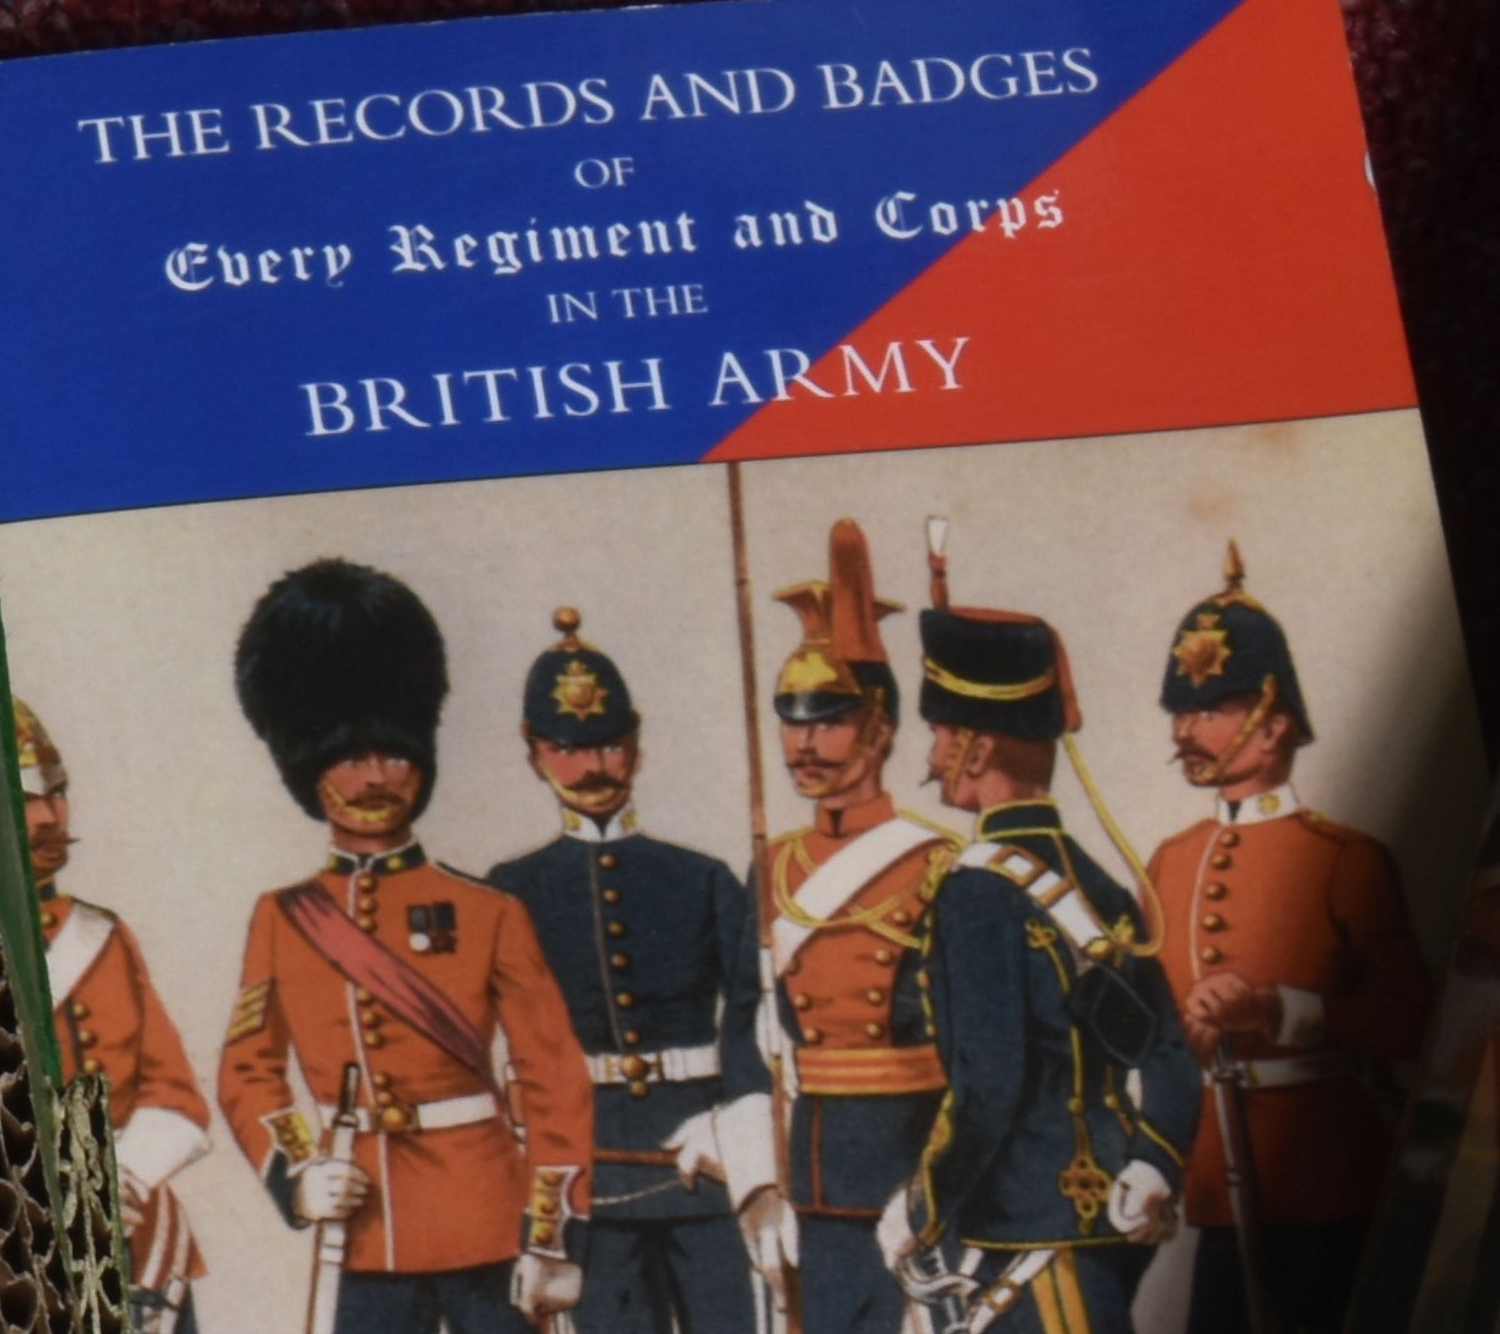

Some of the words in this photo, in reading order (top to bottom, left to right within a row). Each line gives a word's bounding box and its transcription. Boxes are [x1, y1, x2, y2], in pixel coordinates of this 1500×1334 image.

[77, 107, 230, 165] THE
[249, 77, 615, 151] RECORDS
[638, 66, 797, 123] AND
[818, 46, 1100, 112] BADGES
[573, 157, 635, 190] OF
[163, 241, 353, 293] Every
[388, 212, 698, 276] Regiment
[732, 200, 840, 250] and
[874, 188, 1065, 242] Corps
[547, 292, 598, 325] IN
[611, 283, 709, 320] THE
[300, 357, 672, 437] BRITISH
[708, 335, 971, 407] ARMY
